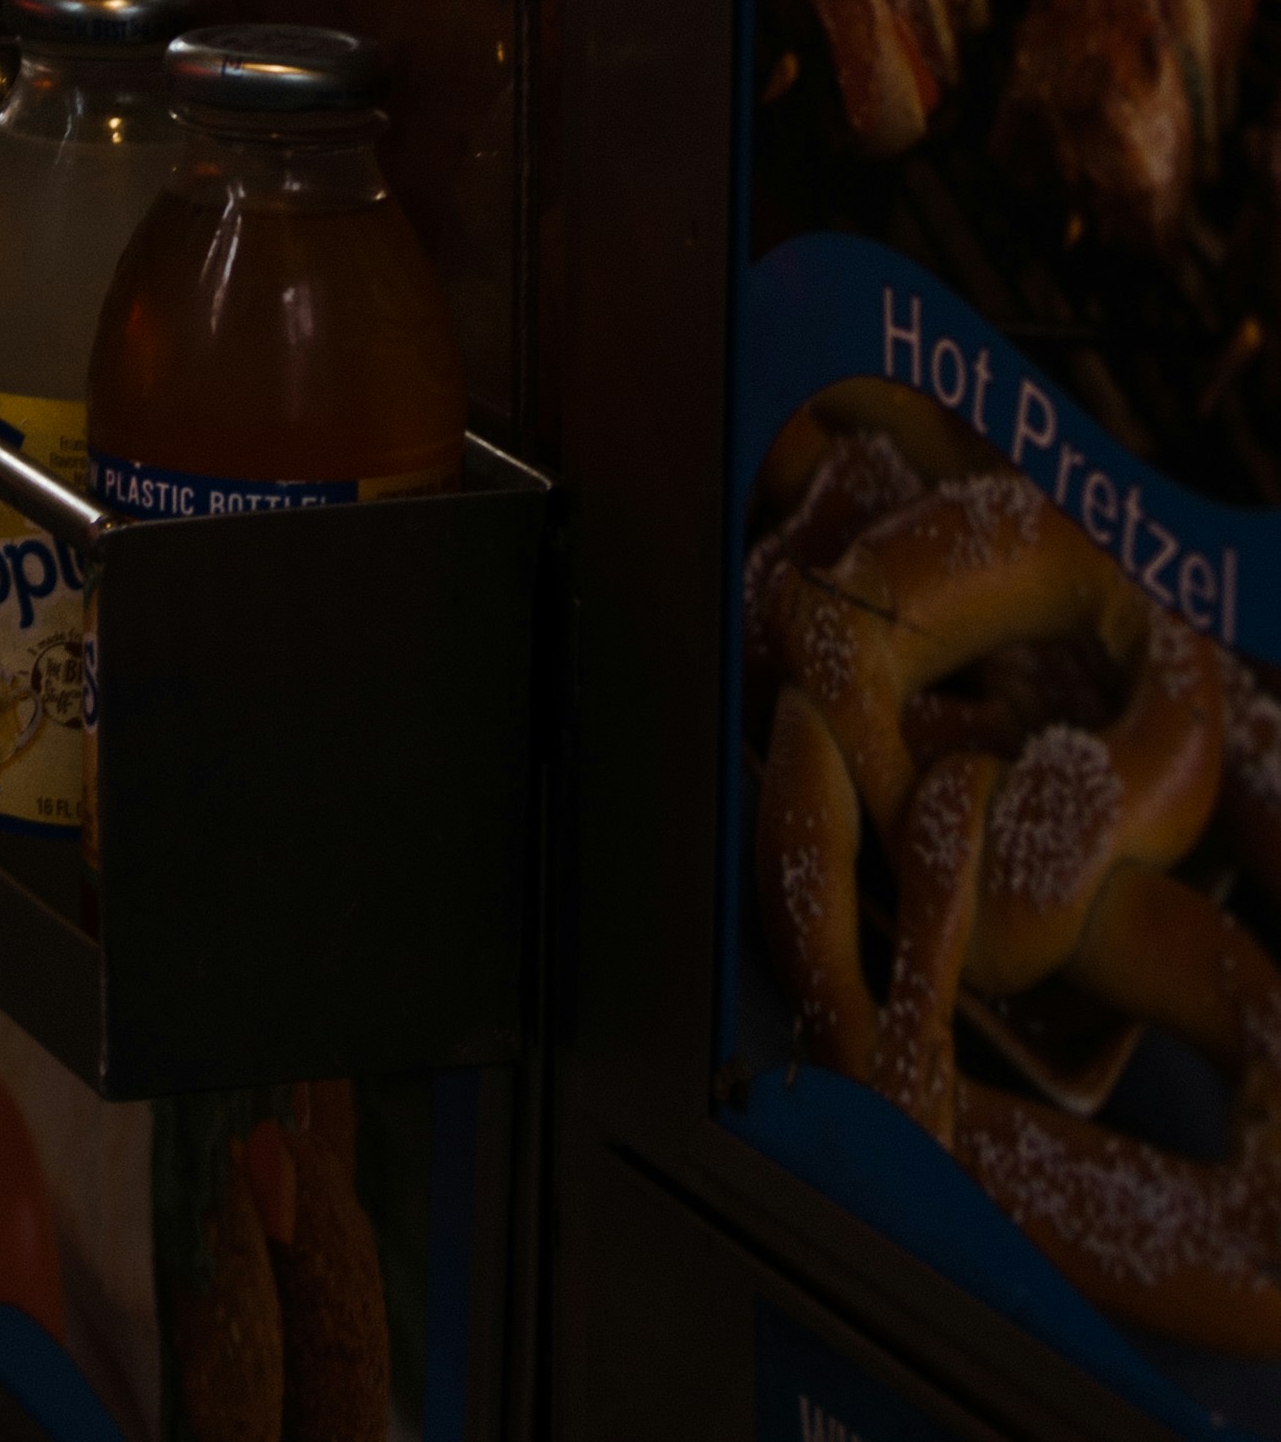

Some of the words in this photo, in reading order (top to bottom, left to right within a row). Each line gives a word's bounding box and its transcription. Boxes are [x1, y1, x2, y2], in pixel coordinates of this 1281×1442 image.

[105, 468, 195, 516] PLASTIC
[882, 285, 995, 437] Hot
[1010, 379, 1240, 644] Pretzel
